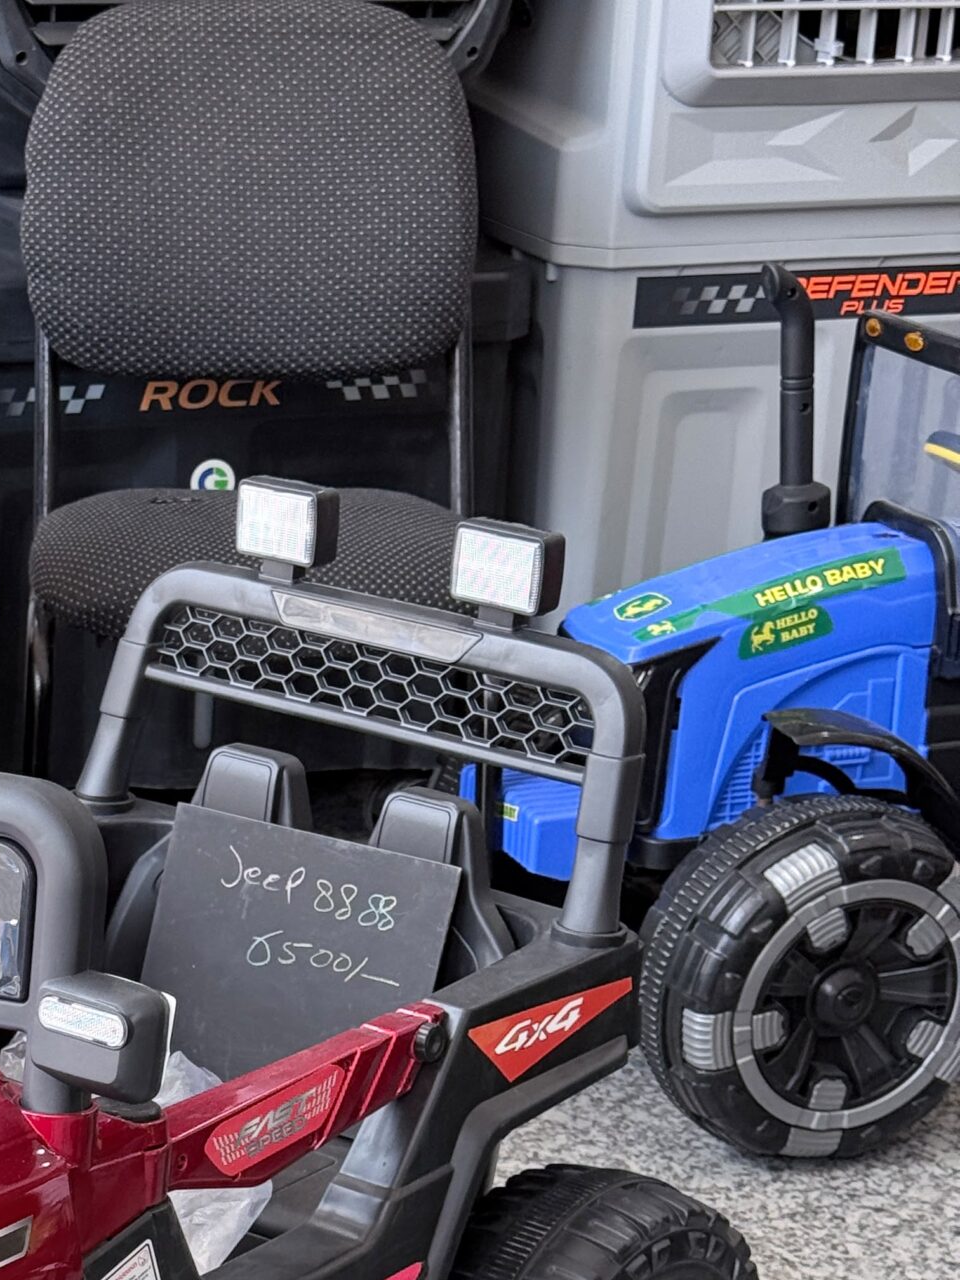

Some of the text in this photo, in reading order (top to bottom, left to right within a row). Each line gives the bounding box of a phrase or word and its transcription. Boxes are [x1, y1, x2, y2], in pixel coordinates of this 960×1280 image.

[840, 299, 905, 315] PLUS
[139, 379, 282, 412] ROCK
[754, 558, 885, 607] HELLO BABY
[775, 608, 818, 629] HELLO
[781, 623, 816, 642] BABY
[314, 879, 397, 930] 8888
[244, 1115, 307, 1157] SPEED
